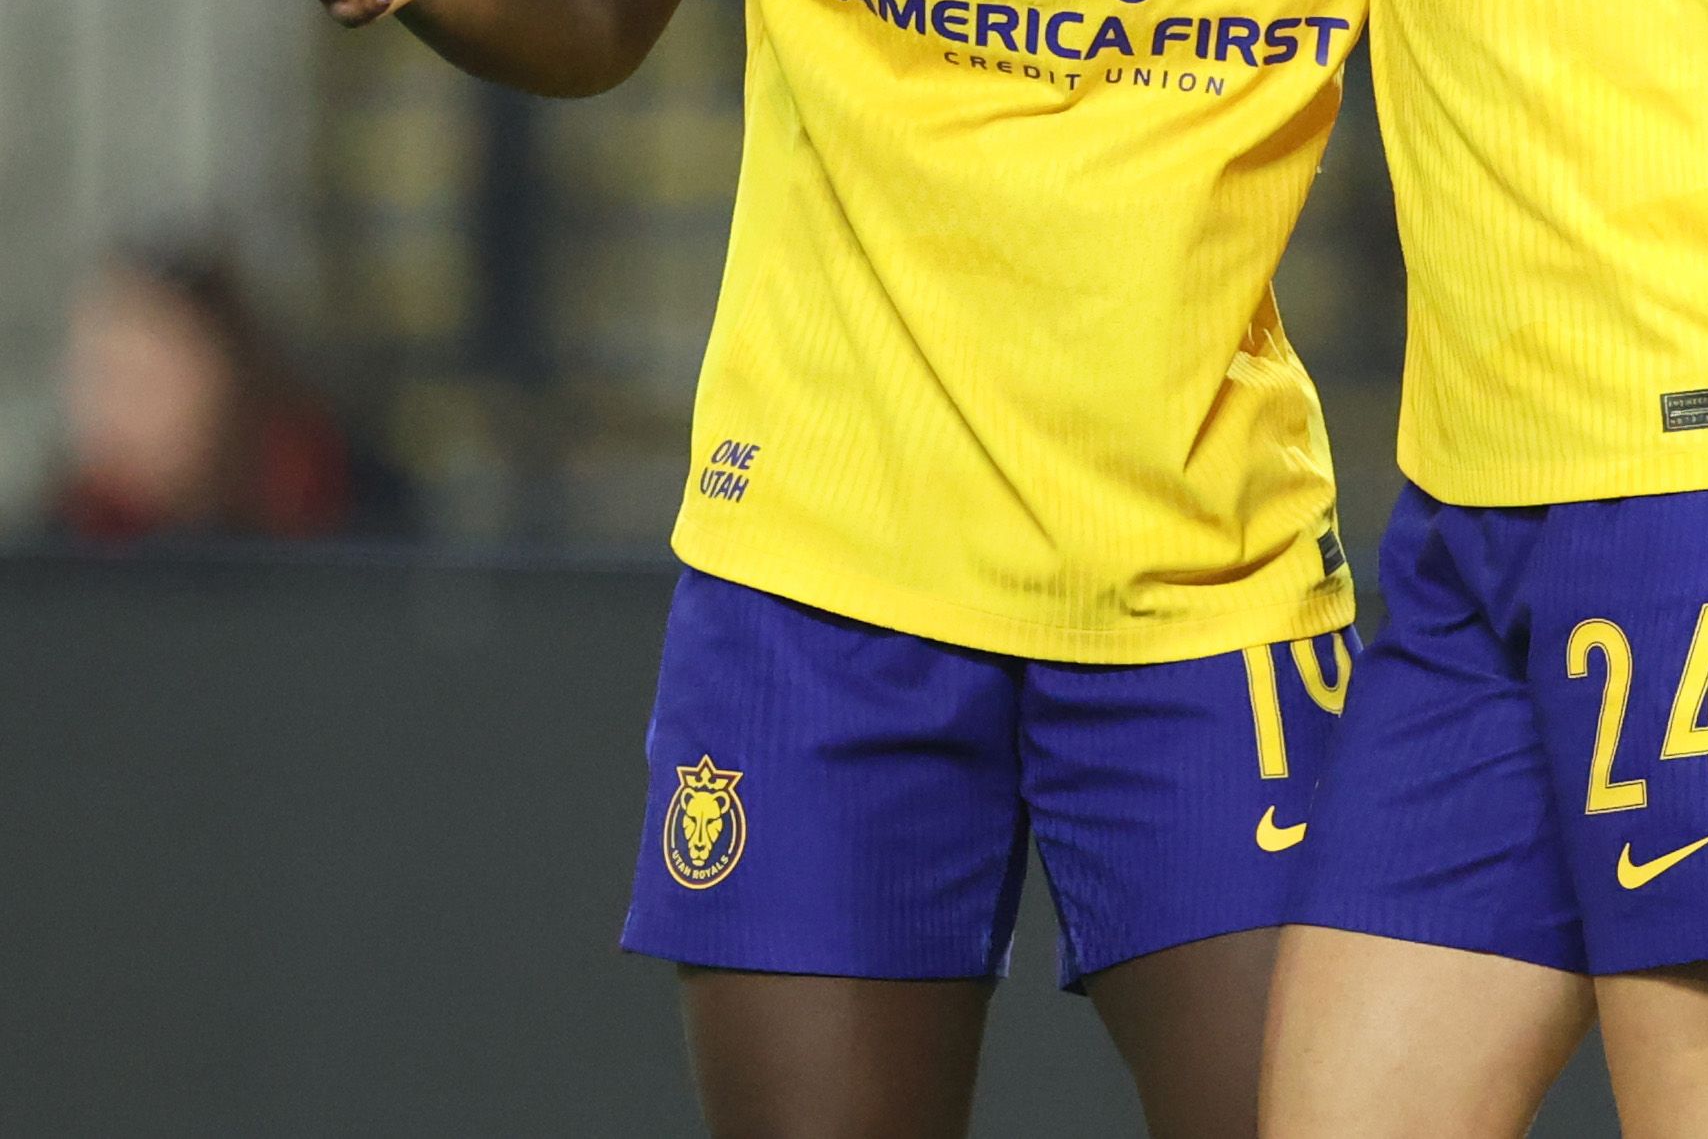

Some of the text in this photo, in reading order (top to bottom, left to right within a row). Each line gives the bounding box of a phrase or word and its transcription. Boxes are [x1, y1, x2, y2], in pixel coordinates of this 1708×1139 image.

[1151, 16, 1350, 68] FIRST
[943, 50, 1225, 96] CREDIT UNION
[711, 439, 760, 470] ONE
[699, 467, 749, 503] UTAH
[672, 849, 729, 880] UTAH ROYALS
